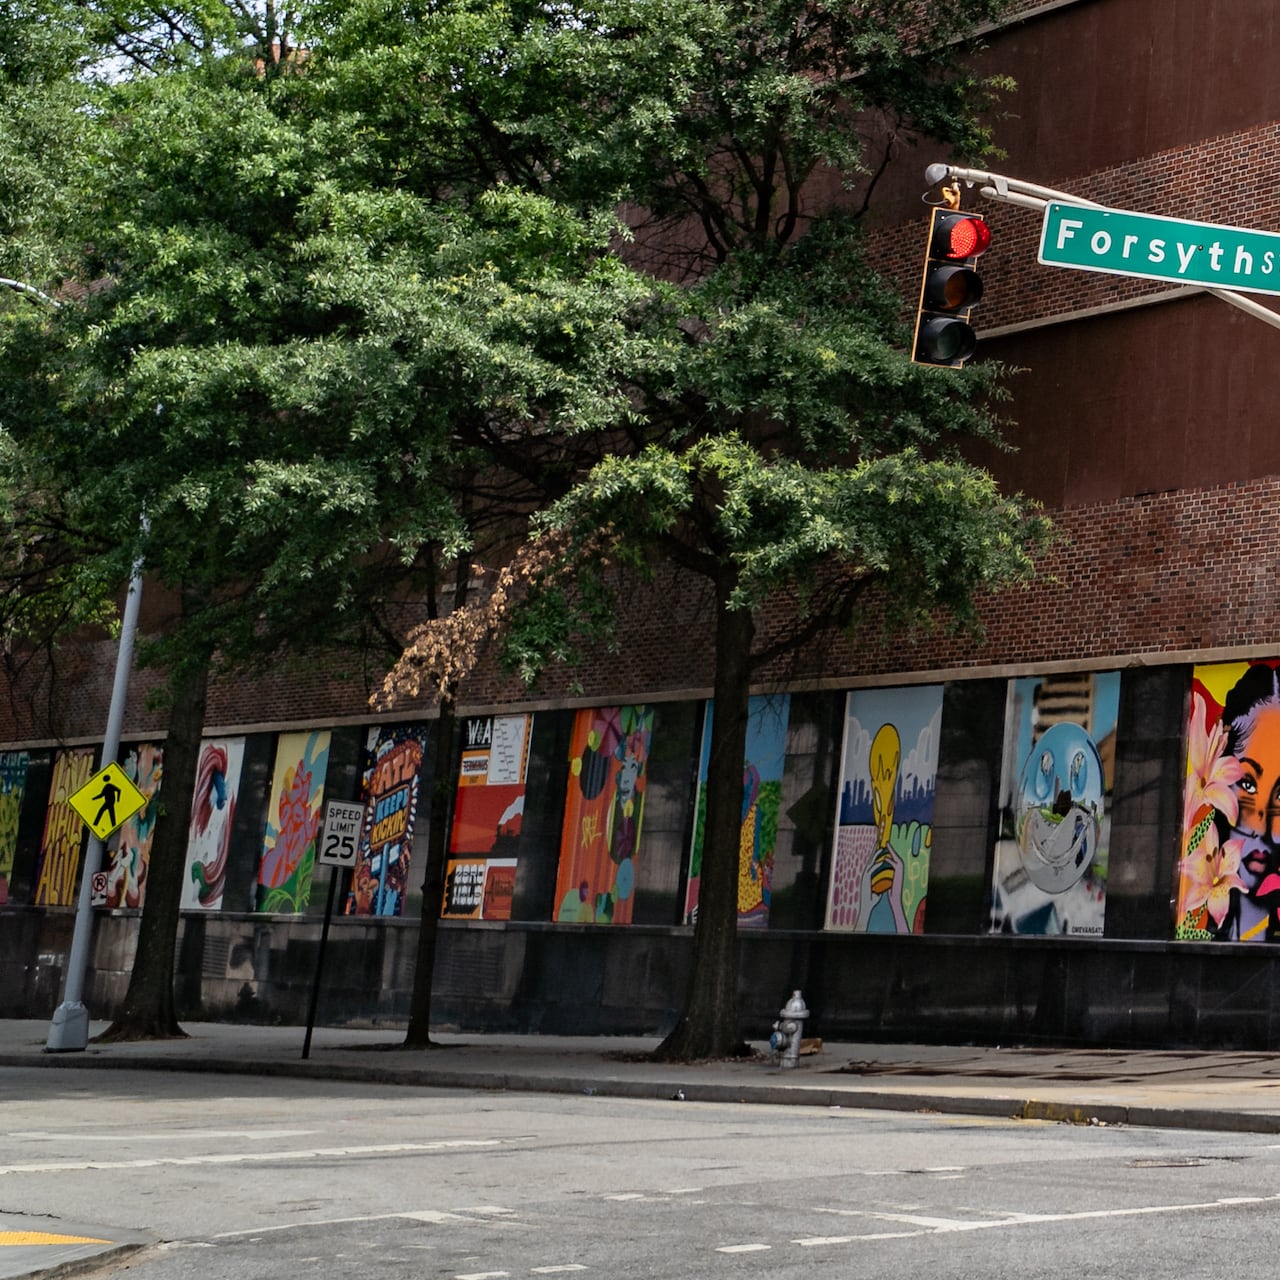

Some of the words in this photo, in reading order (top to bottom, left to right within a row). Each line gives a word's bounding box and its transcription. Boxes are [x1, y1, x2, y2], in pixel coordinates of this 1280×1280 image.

[1056, 218, 1253, 274] Forsyth
[377, 748, 416, 794] ATL
[329, 807, 361, 821] SPEED
[375, 788, 409, 824] KEEPS
[330, 821, 356, 833] LIMIT
[324, 834, 355, 859] 25
